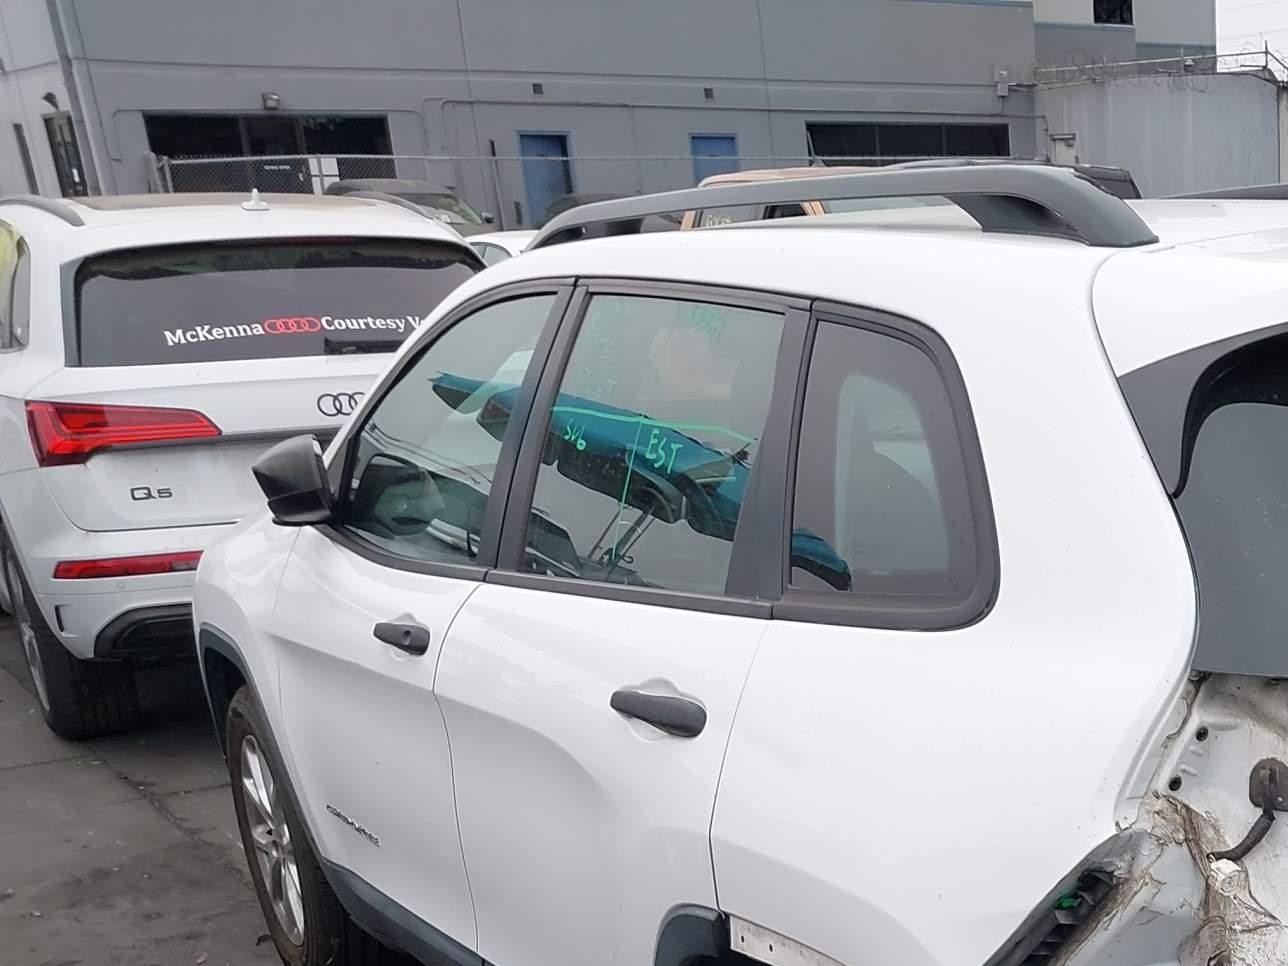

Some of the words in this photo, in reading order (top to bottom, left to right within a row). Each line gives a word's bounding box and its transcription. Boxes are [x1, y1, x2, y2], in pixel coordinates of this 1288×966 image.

[164, 321, 265, 346] McKenna
[320, 316, 406, 333] Courtesy
[645, 427, 684, 474] EST
[130, 486, 173, 501] Q5
